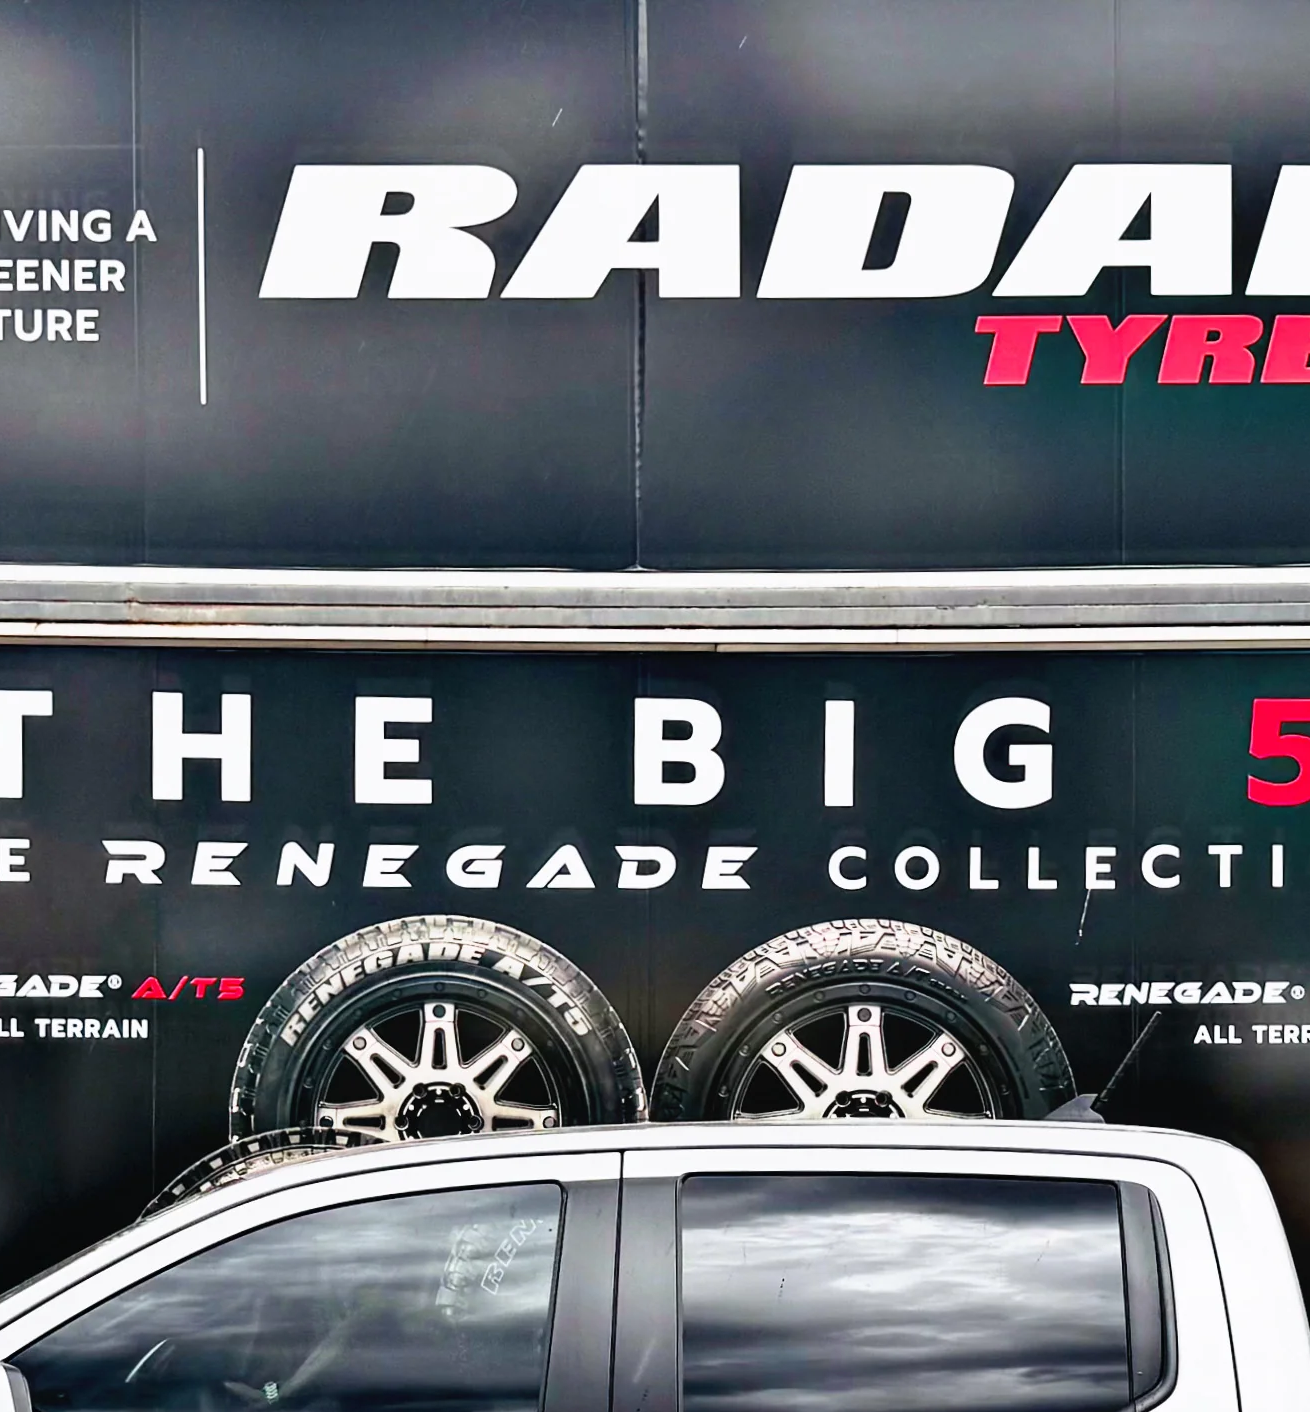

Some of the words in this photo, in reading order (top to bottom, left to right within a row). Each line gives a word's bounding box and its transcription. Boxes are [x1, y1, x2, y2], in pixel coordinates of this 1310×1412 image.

[126, 209, 157, 243] A
[634, 696, 1053, 809] BIG
[102, 840, 758, 889] RENEGADE
[131, 974, 246, 1001] A/T5
[281, 942, 486, 1046] RENEGADE
[34, 1018, 149, 1039] TERRAIN
[1193, 1024, 1243, 1044] ALL
